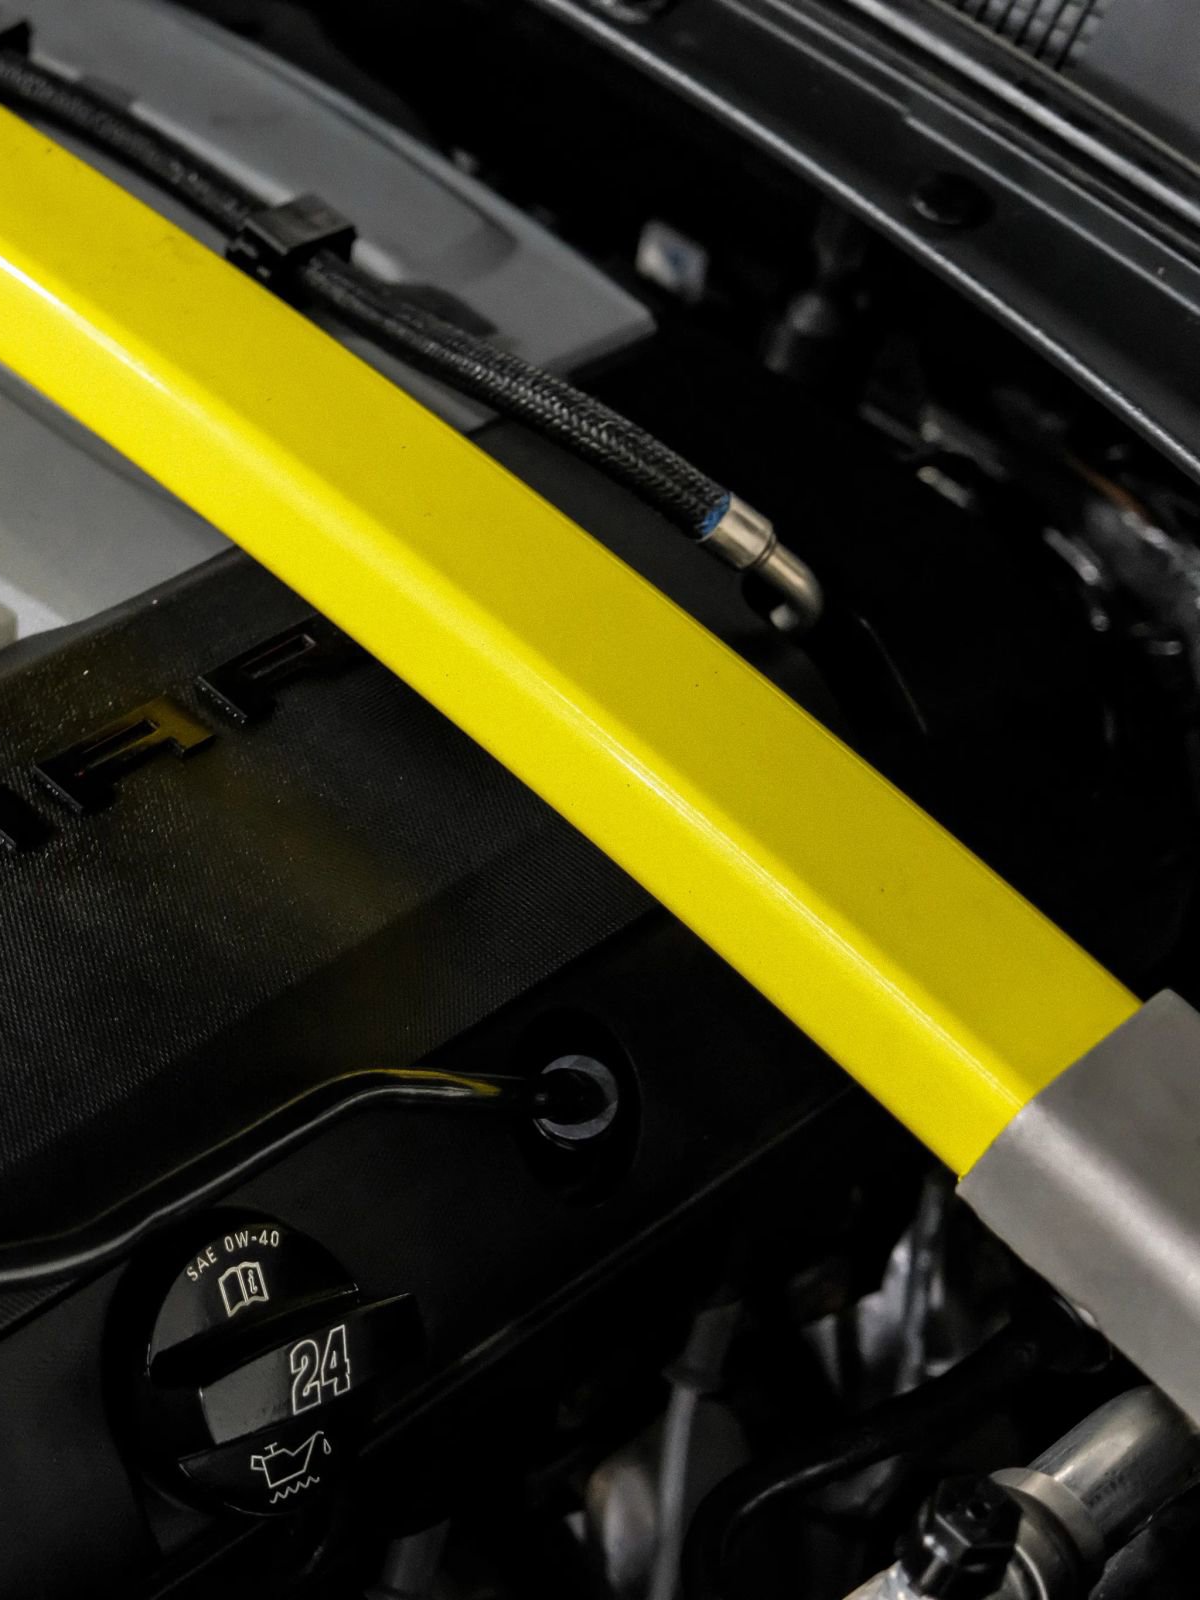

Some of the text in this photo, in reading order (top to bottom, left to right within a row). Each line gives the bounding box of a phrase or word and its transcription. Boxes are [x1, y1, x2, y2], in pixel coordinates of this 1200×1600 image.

[187, 1230, 280, 1282] SAE 0W-40
[290, 1324, 350, 1416] 24
